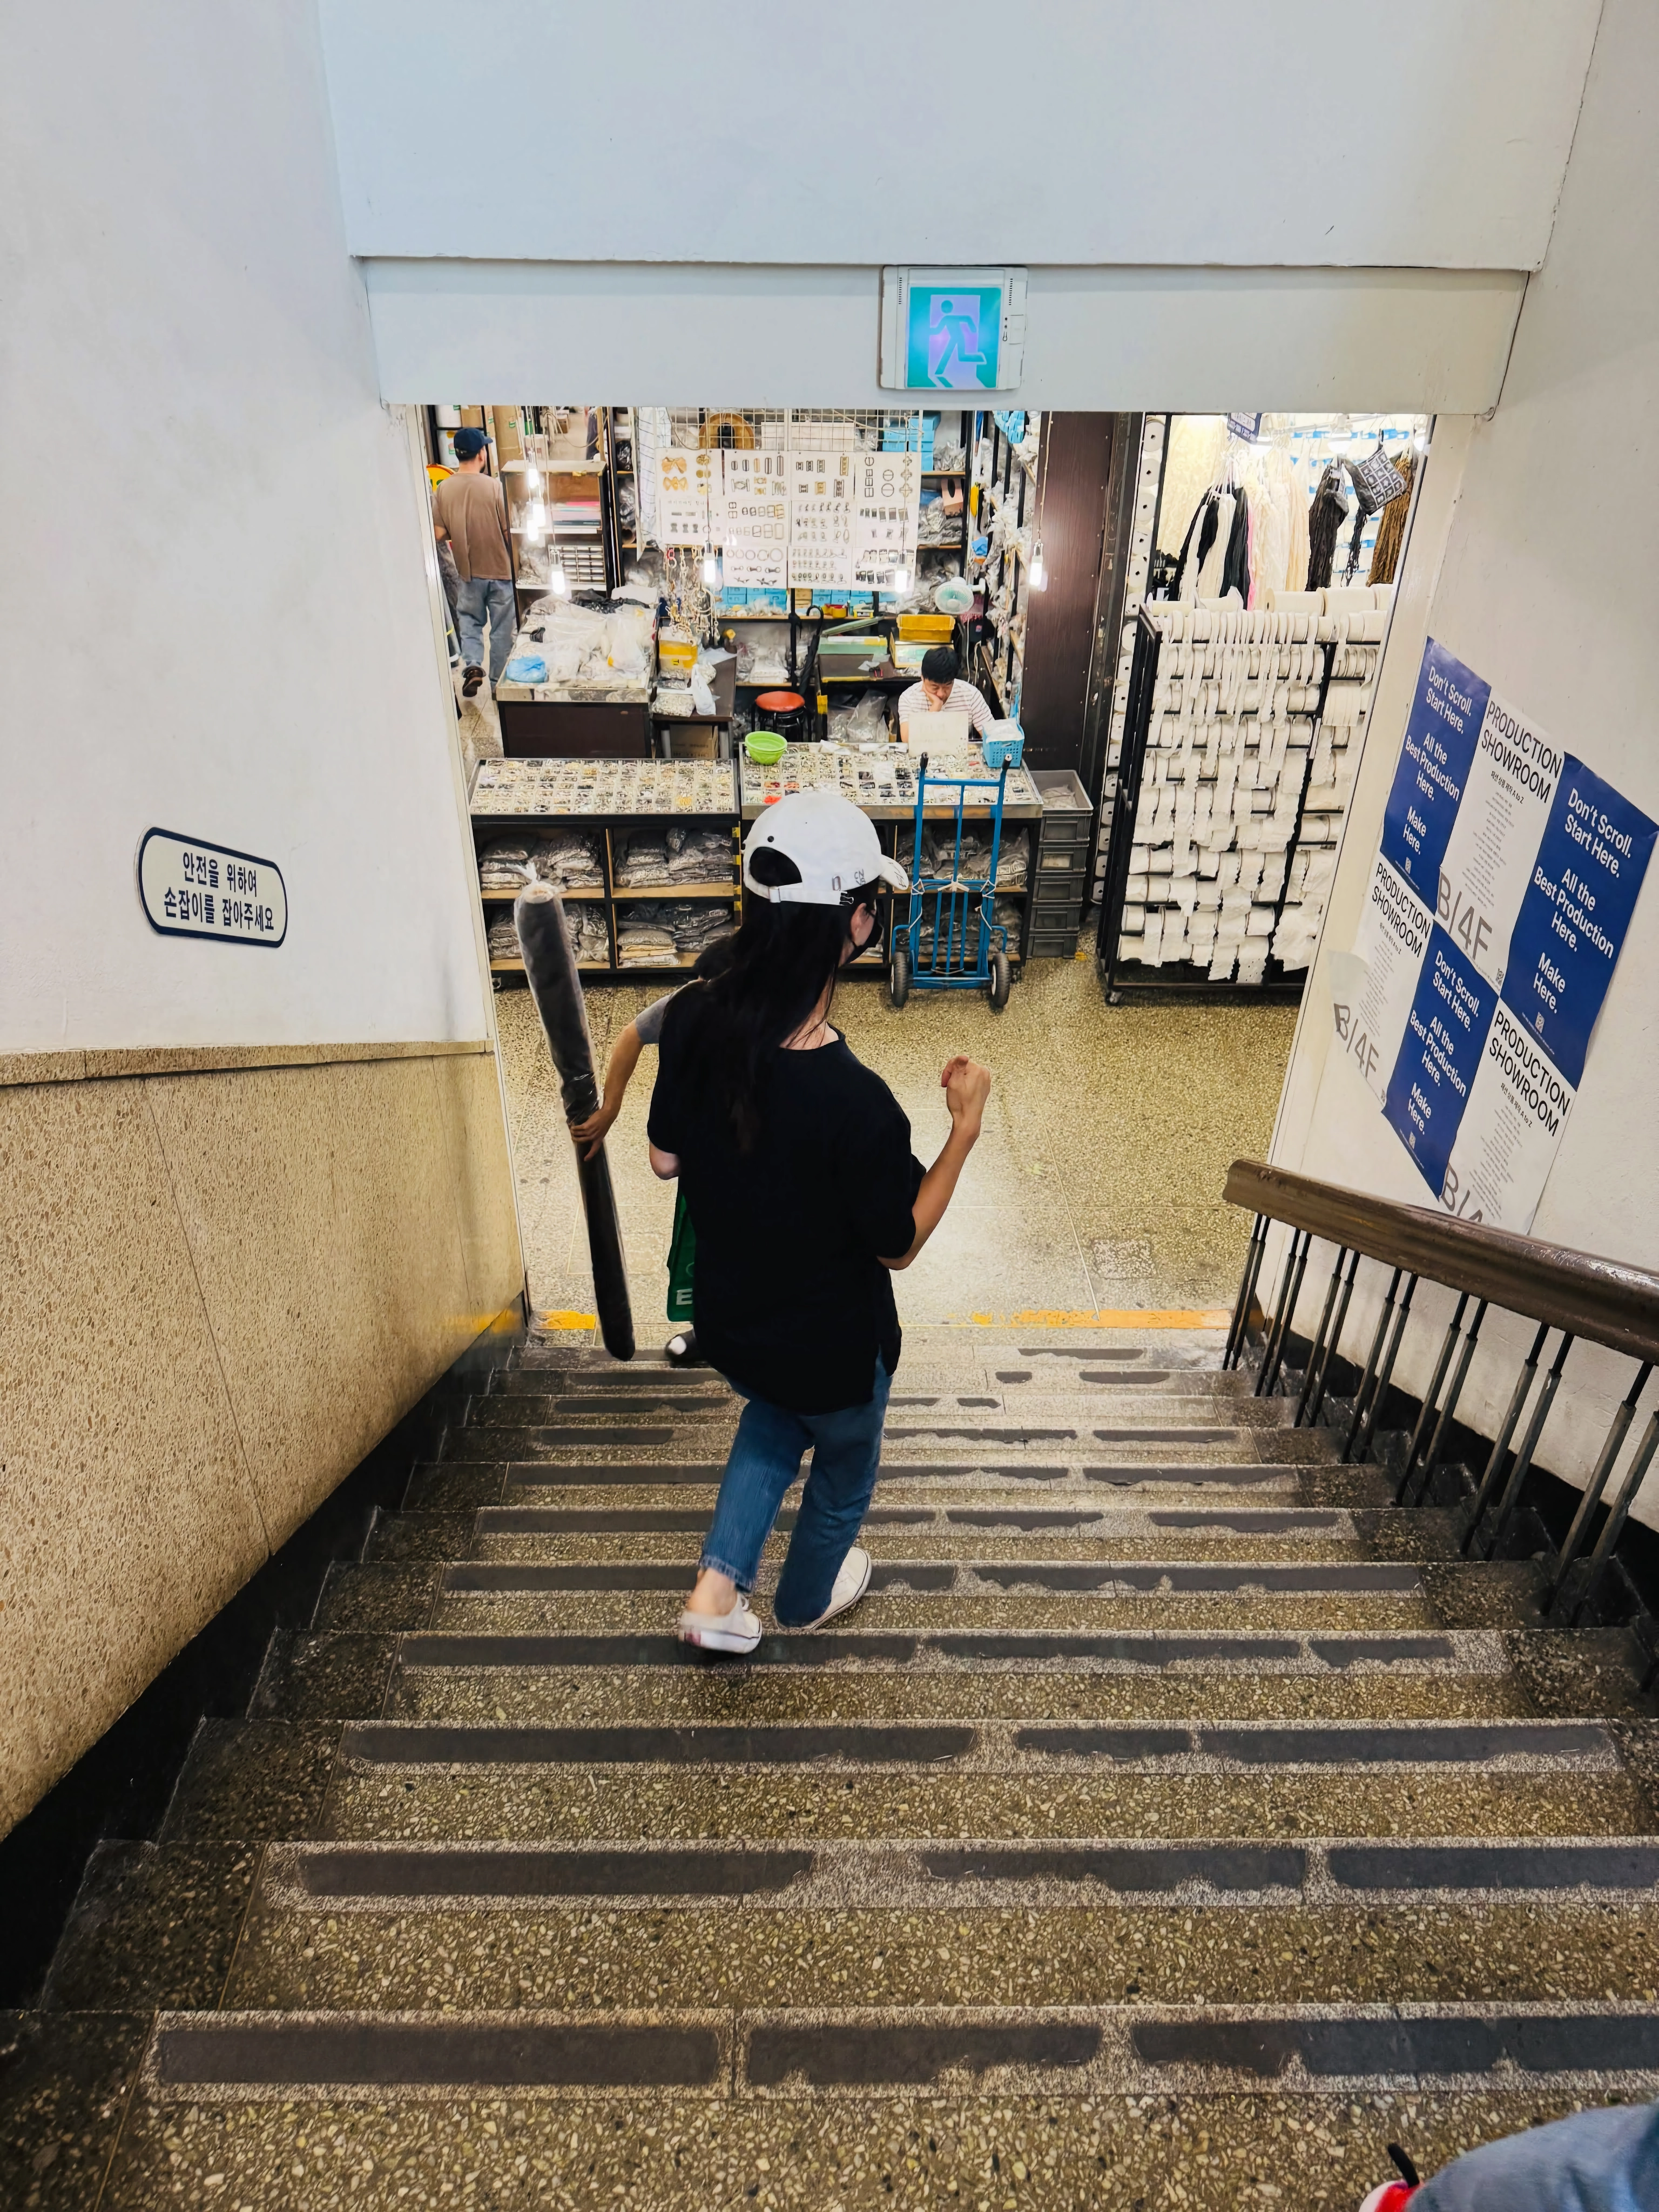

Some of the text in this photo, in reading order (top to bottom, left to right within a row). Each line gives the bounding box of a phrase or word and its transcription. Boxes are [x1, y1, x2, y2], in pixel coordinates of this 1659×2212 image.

[1426, 687, 1464, 734] Start Here.
[1428, 665, 1472, 717] Don't Scroll.
[1424, 733, 1447, 765] All the
[1486, 700, 1562, 778] PRODUCTION
[1405, 734, 1460, 801] Best Production
[1417, 770, 1434, 801] Here.
[1481, 729, 1552, 804] SHOWROOM
[1403, 824, 1421, 855] Here.
[1407, 805, 1426, 837] Make
[1564, 814, 1620, 878] Start Here.
[1568, 787, 1633, 858] Don't Scroll.
[183, 852, 257, 897] 안전을 위하여
[1376, 862, 1431, 939] PRODUCTION
[1561, 868, 1596, 911] All the
[164, 886, 274, 932] 손잡이를 잡아주세요
[1372, 886, 1422, 957] SHOWROOM
[1437, 871, 1493, 960] B/4F
[1534, 866, 1614, 959] Best Production
[1551, 911, 1577, 952] Here.
[1435, 950, 1480, 1017] Don't Scroll.
[1533, 972, 1557, 1014] Here.
[1538, 952, 1566, 993] Make
[1433, 972, 1471, 1032] Start Here.
[1333, 1003, 1379, 1078] B/4F
[1410, 1009, 1467, 1097] Best Production
[1430, 1016, 1454, 1055] All the
[1421, 1050, 1440, 1087] Here.
[1489, 1037, 1559, 1137] SHOWROOM
[1494, 1010, 1570, 1116] PRODUCTION
[1408, 1098, 1425, 1135] Here.
[1411, 1082, 1432, 1119] Make
